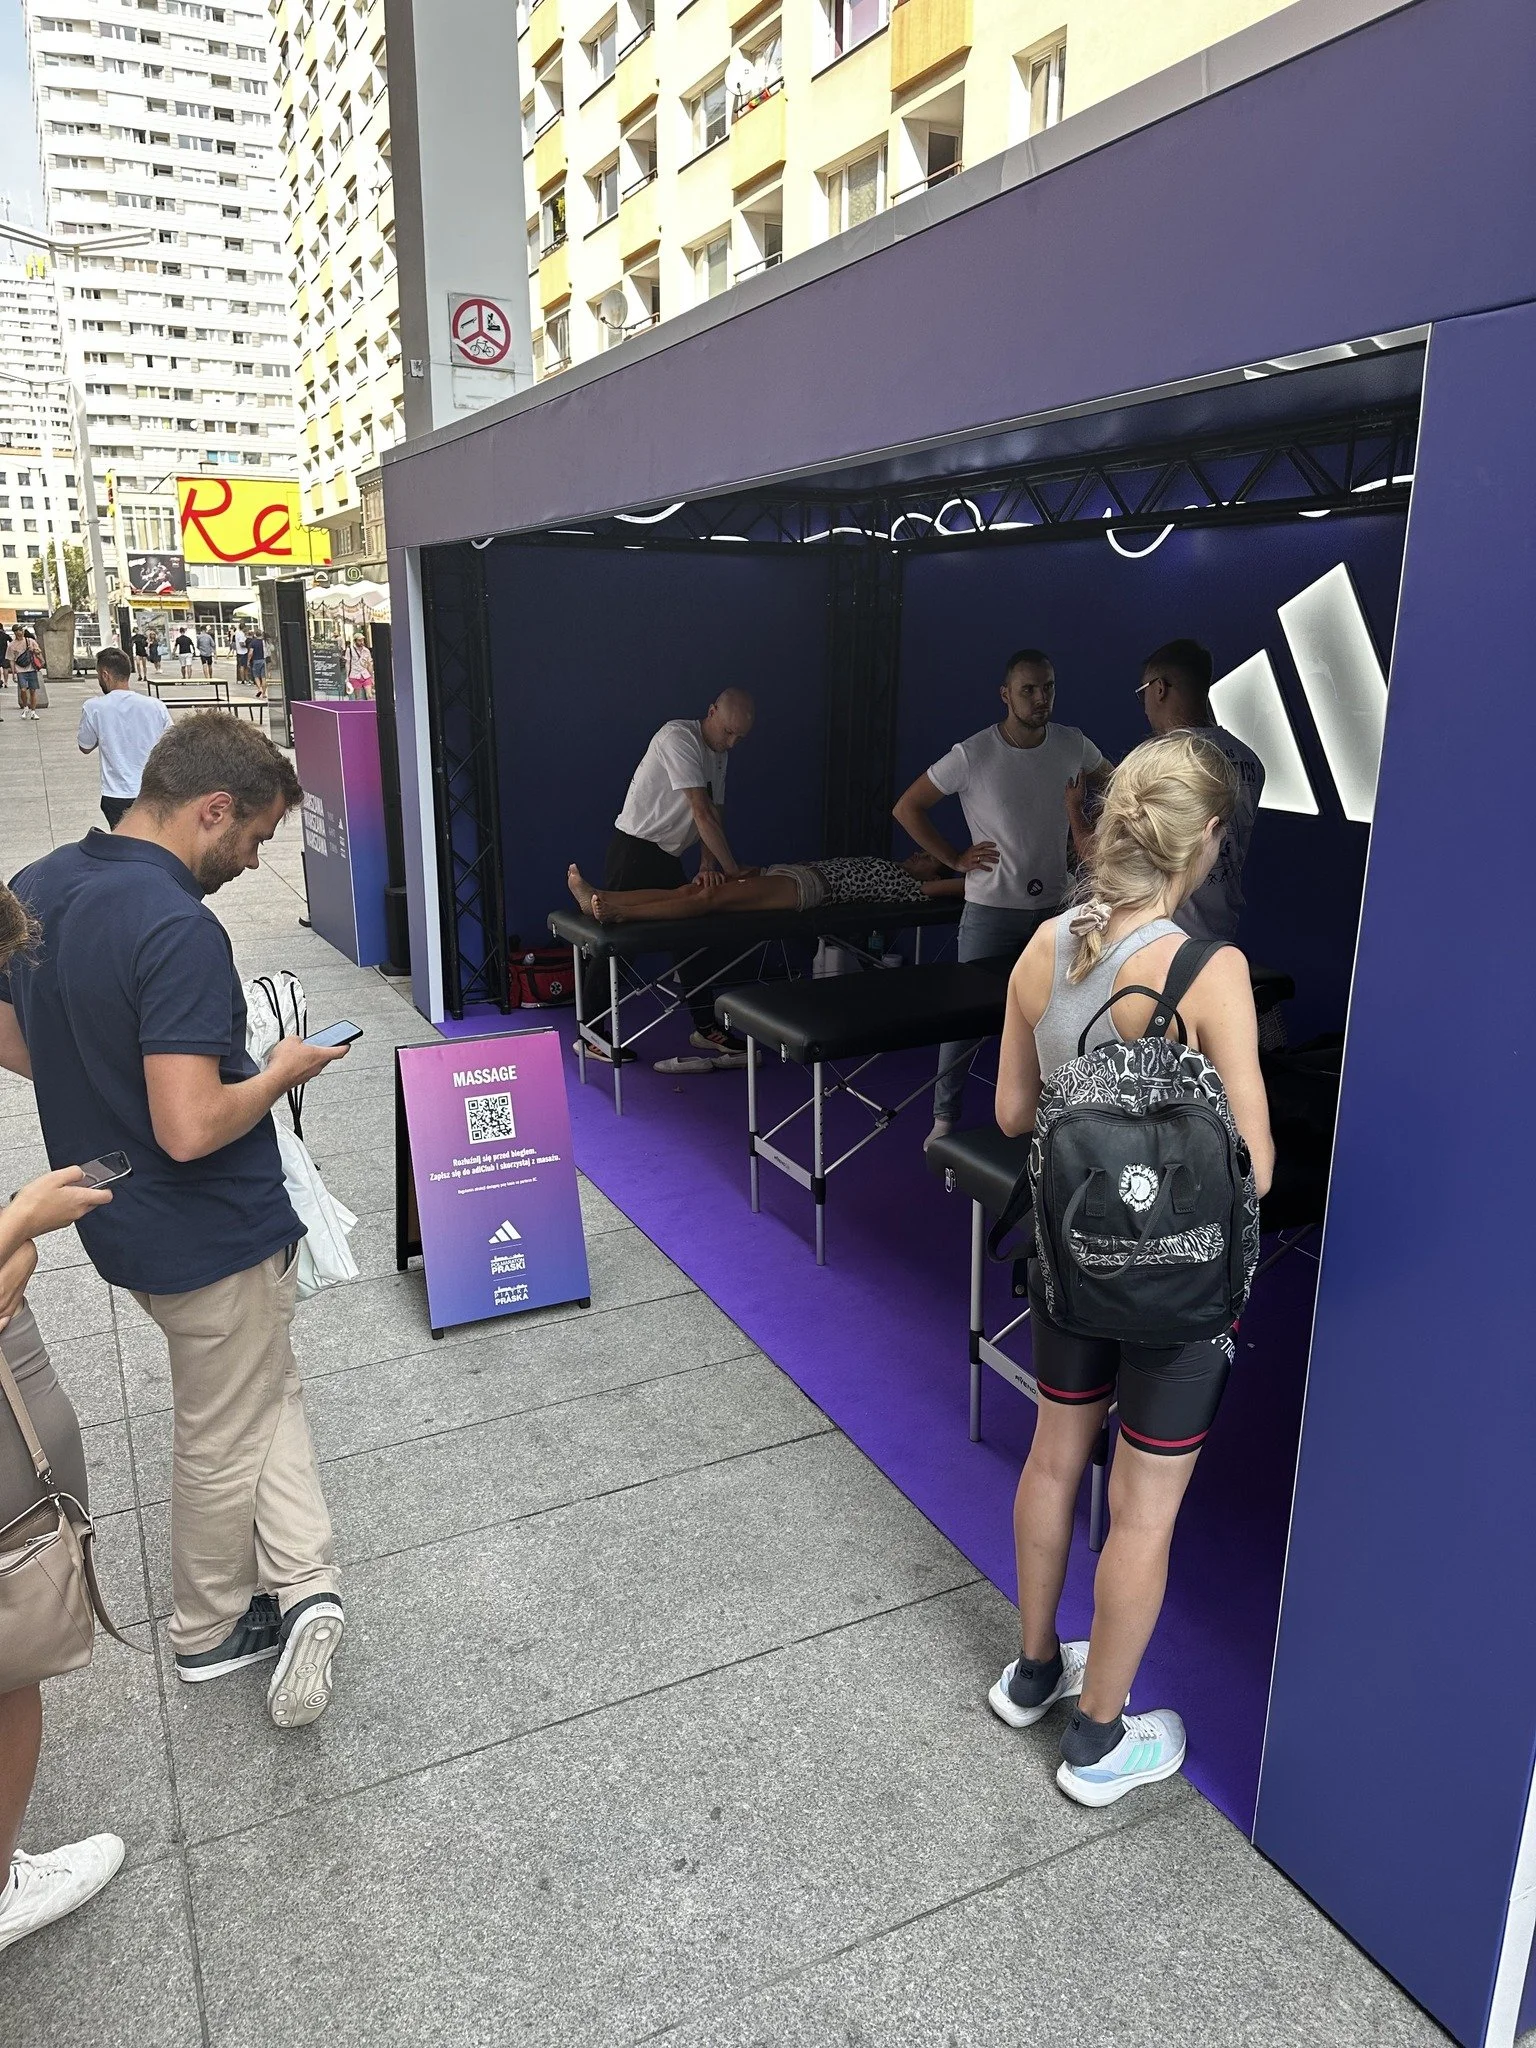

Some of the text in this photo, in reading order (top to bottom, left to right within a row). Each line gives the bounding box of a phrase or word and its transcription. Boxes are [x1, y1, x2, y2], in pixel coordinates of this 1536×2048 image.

[453, 1065, 518, 1088] MASSAGE
[492, 1151, 510, 1162] przed
[510, 1148, 537, 1158] biegiem.
[429, 1173, 451, 1181] Zapisz
[462, 1168, 471, 1176] do
[471, 1164, 496, 1175] adiClub
[499, 1158, 531, 1170] skorzystaj
[491, 1262, 526, 1275] PRASKI
[494, 1293, 529, 1306] PRASKA
